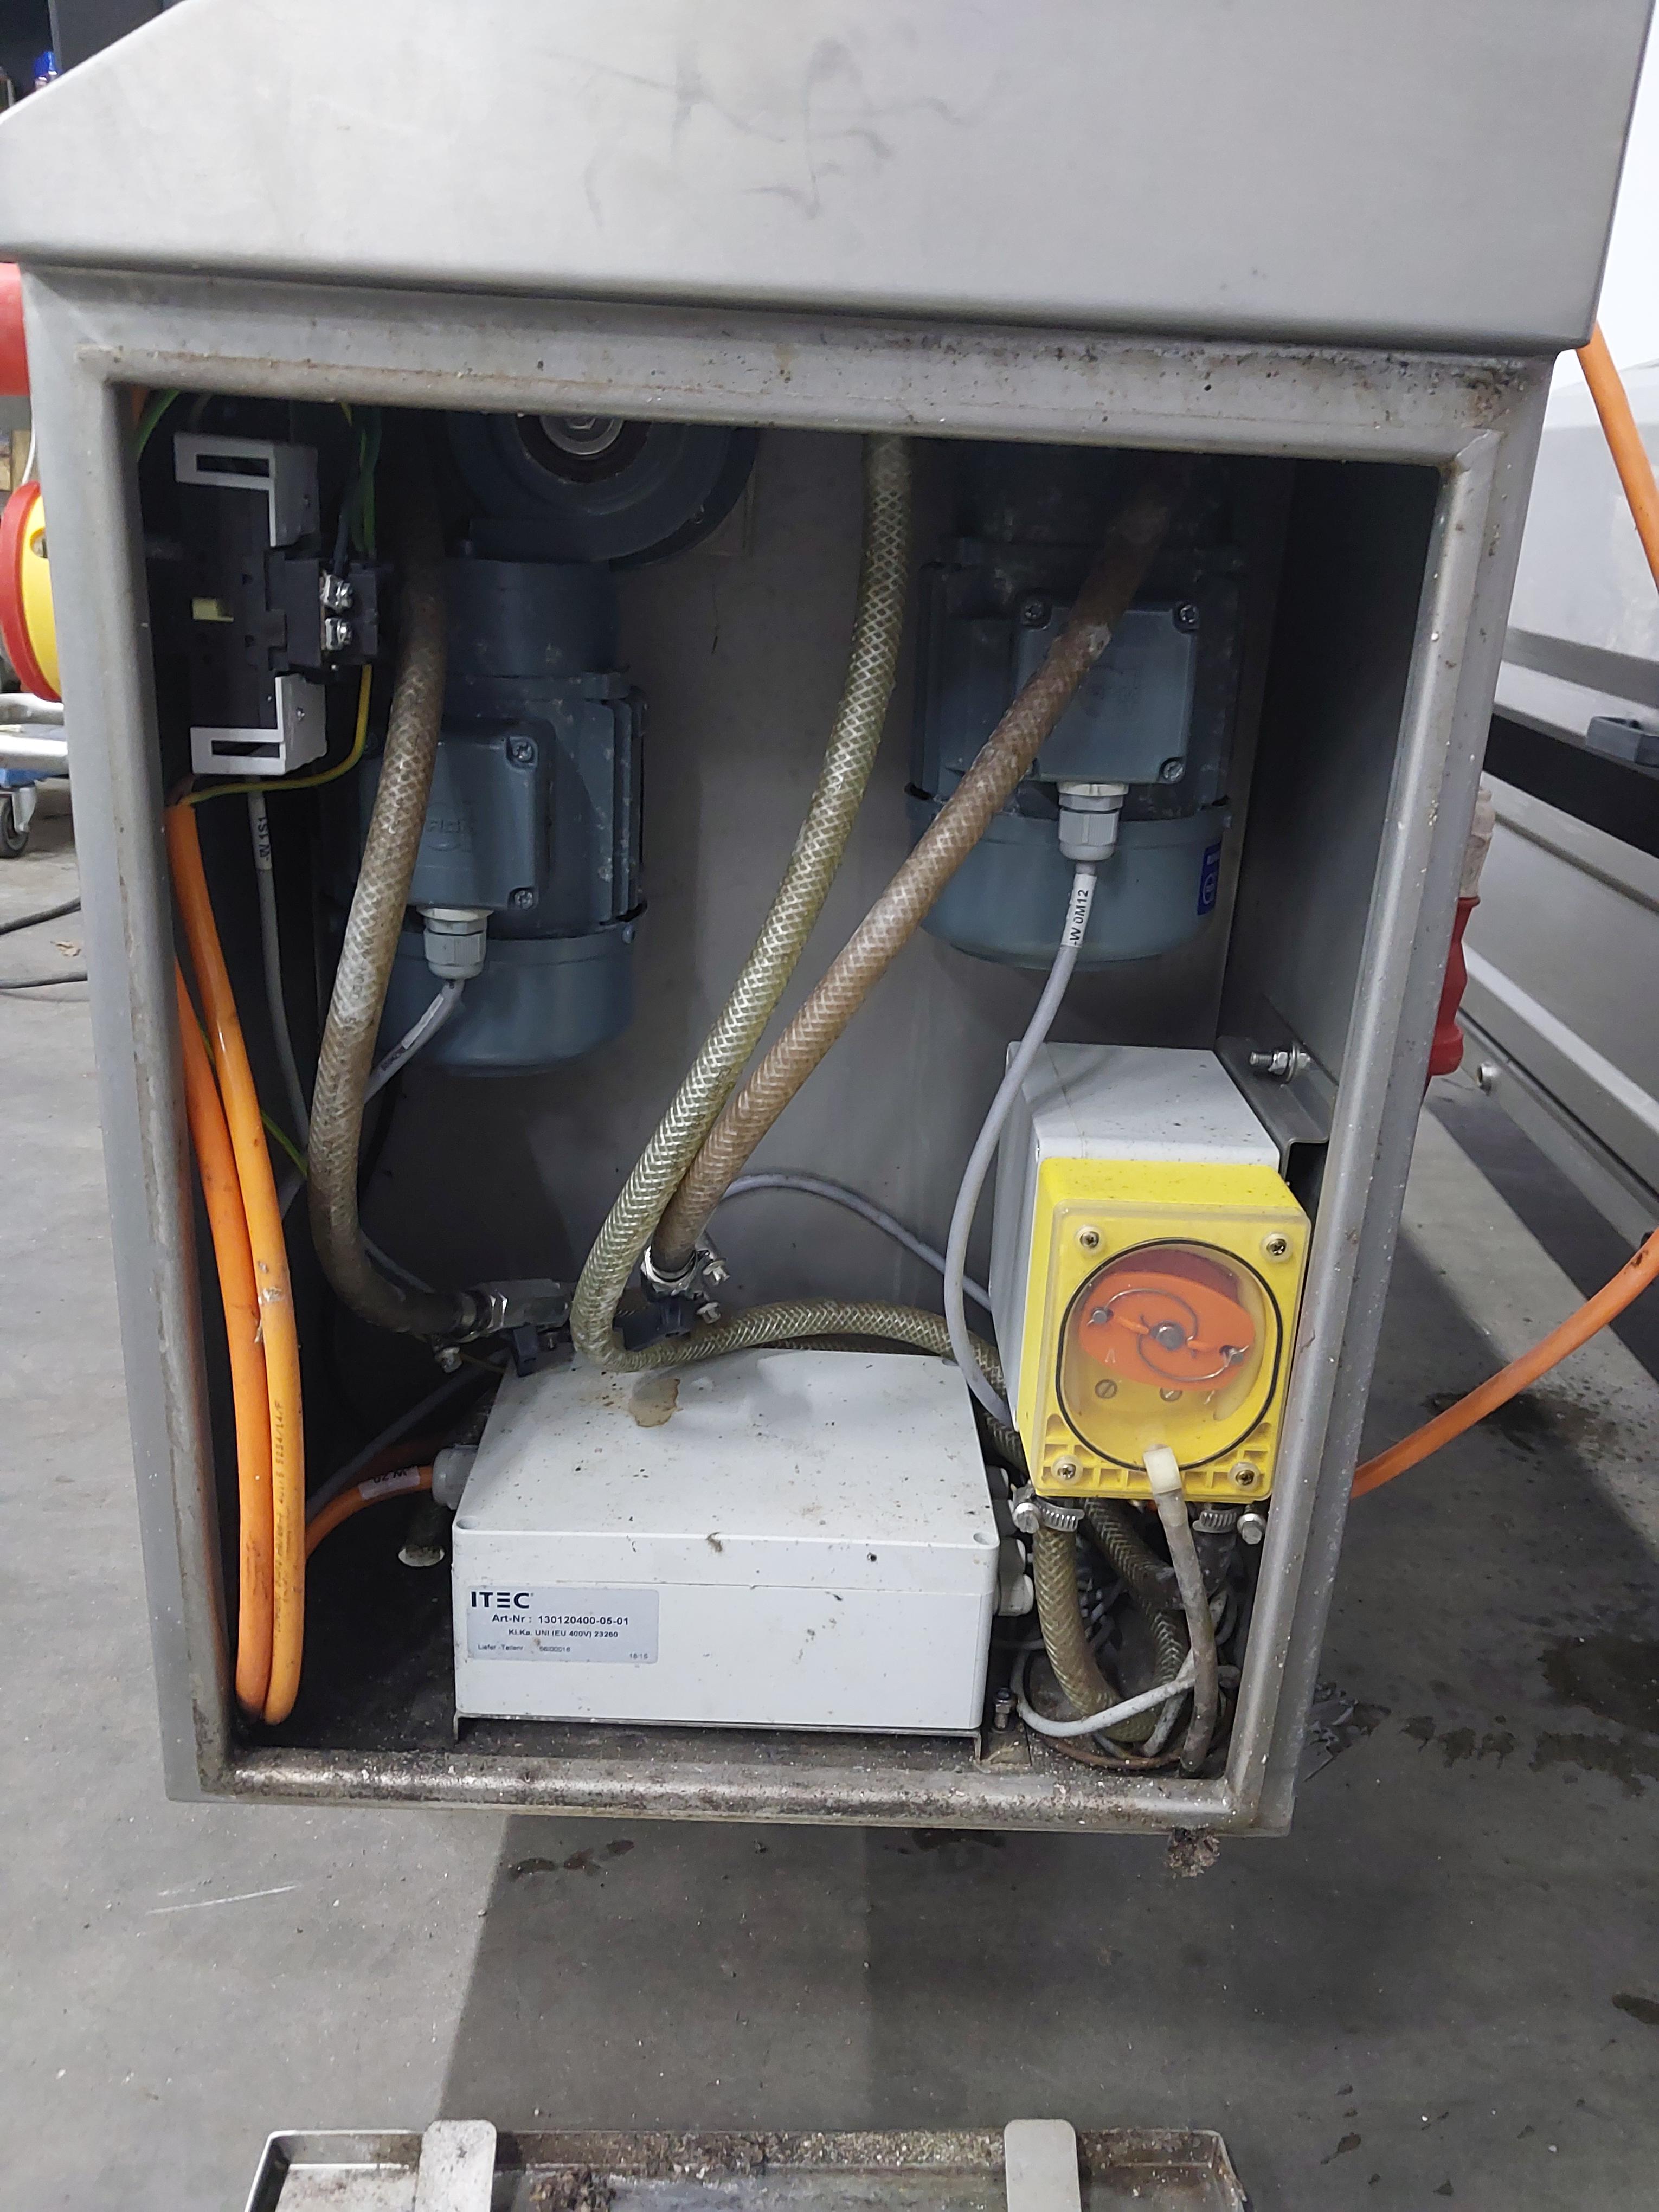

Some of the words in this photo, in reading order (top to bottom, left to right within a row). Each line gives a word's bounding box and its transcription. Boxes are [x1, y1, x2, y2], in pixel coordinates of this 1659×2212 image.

[1069, 927, 1081, 946] -W
[471, 1591, 530, 1609] ITEC
[538, 1616, 629, 1625] 130120400-05-01
[569, 1630, 592, 1638] 400V)
